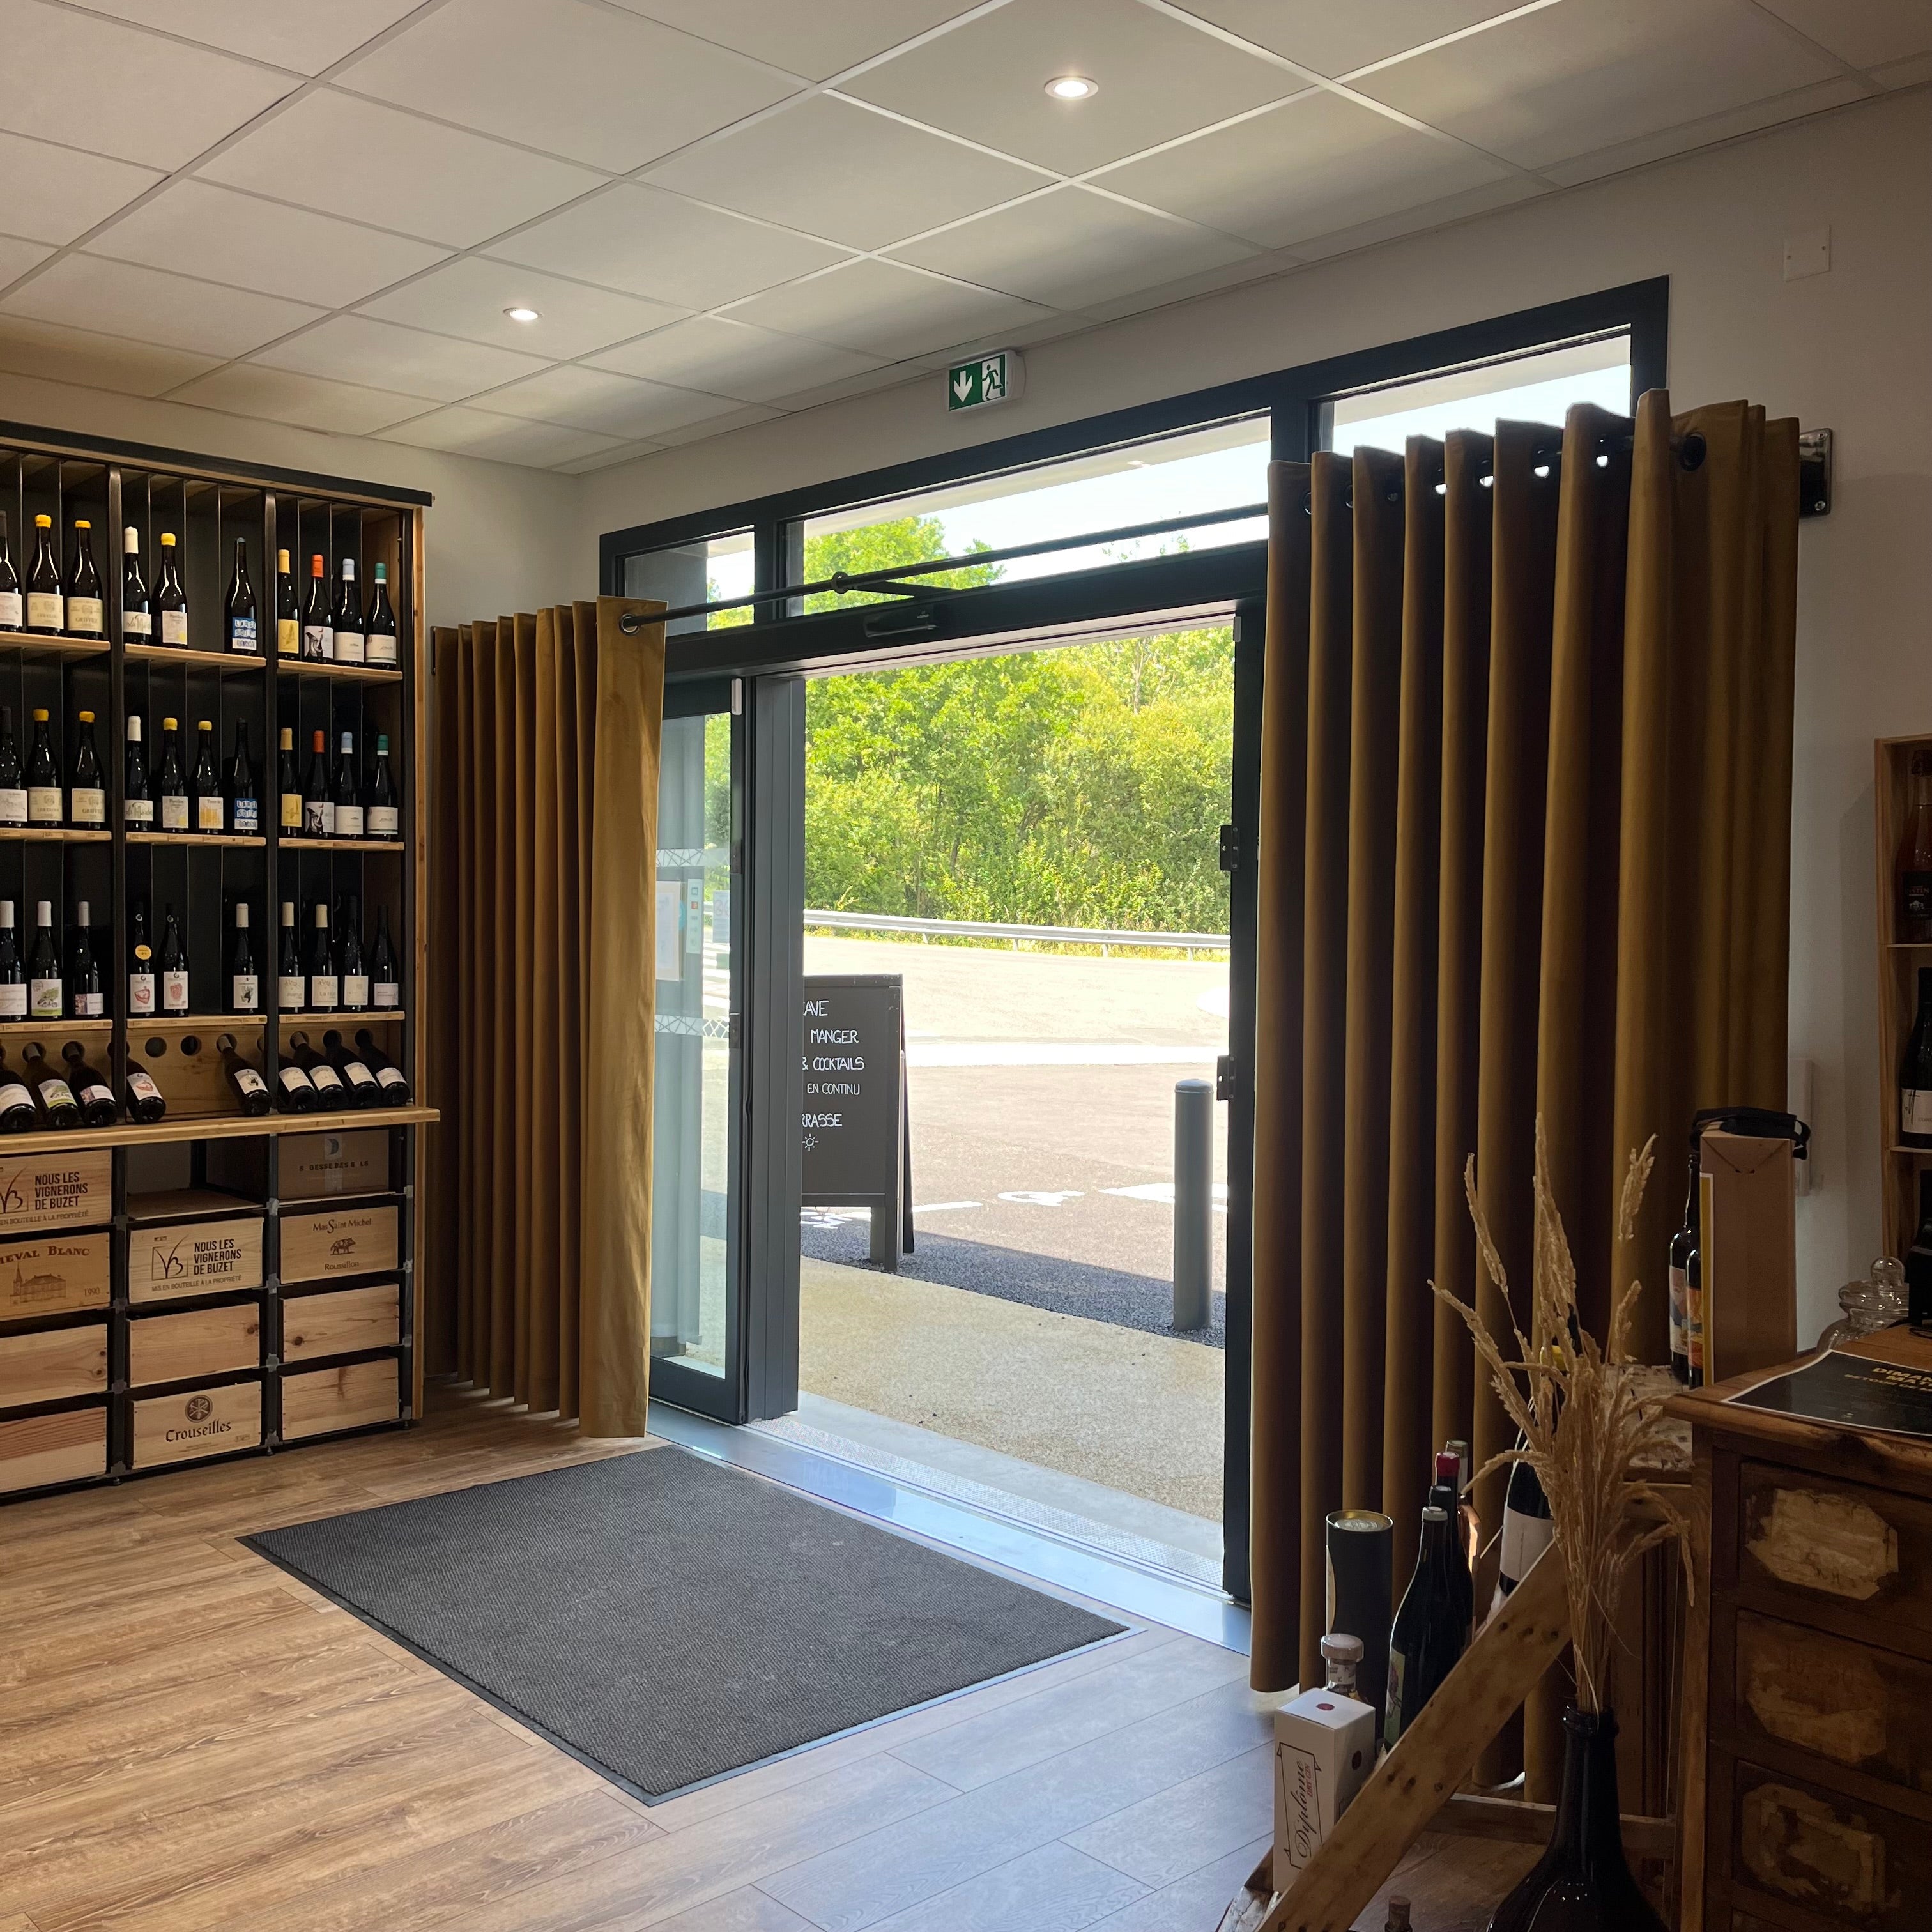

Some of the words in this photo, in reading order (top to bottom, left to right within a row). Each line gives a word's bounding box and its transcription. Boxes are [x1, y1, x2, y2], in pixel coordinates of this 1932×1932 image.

[802, 1000, 829, 1016] AVE
[810, 1029, 859, 1045] MANGER
[813, 1056, 865, 1071] COCKTAILS
[807, 1083, 819, 1094] EN
[822, 1082, 860, 1096] CONTINU
[351, 1160, 369, 1169] SLS
[35, 1172, 60, 1186] NOUS
[63, 1171, 80, 1183] LES
[35, 1183, 88, 1198] VIGNERONS
[35, 1198, 47, 1211] DE
[50, 1195, 80, 1209] BUZET
[10, 1215, 41, 1225] BOUTEILLE
[57, 1210, 89, 1220] PROPRIÉTÉ
[313, 1223, 328, 1232] Mas
[326, 1219, 346, 1234] Saint
[348, 1218, 372, 1227] Michel
[194, 1241, 217, 1253] NOUS
[219, 1238, 235, 1249] LES
[194, 1249, 241, 1264] VIGNERONS
[194, 1264, 204, 1276] DE
[207, 1261, 234, 1274] BUZET
[325, 1260, 360, 1271] Roussillon
[171, 1280, 199, 1290] BOUTEILLE
[213, 1274, 242, 1284] PROPRIÉTÉ
[84, 1287, 100, 1298] 1990
[165, 1418, 231, 1442] Crouseilles
[1290, 1760, 1317, 1858] Diplôme
